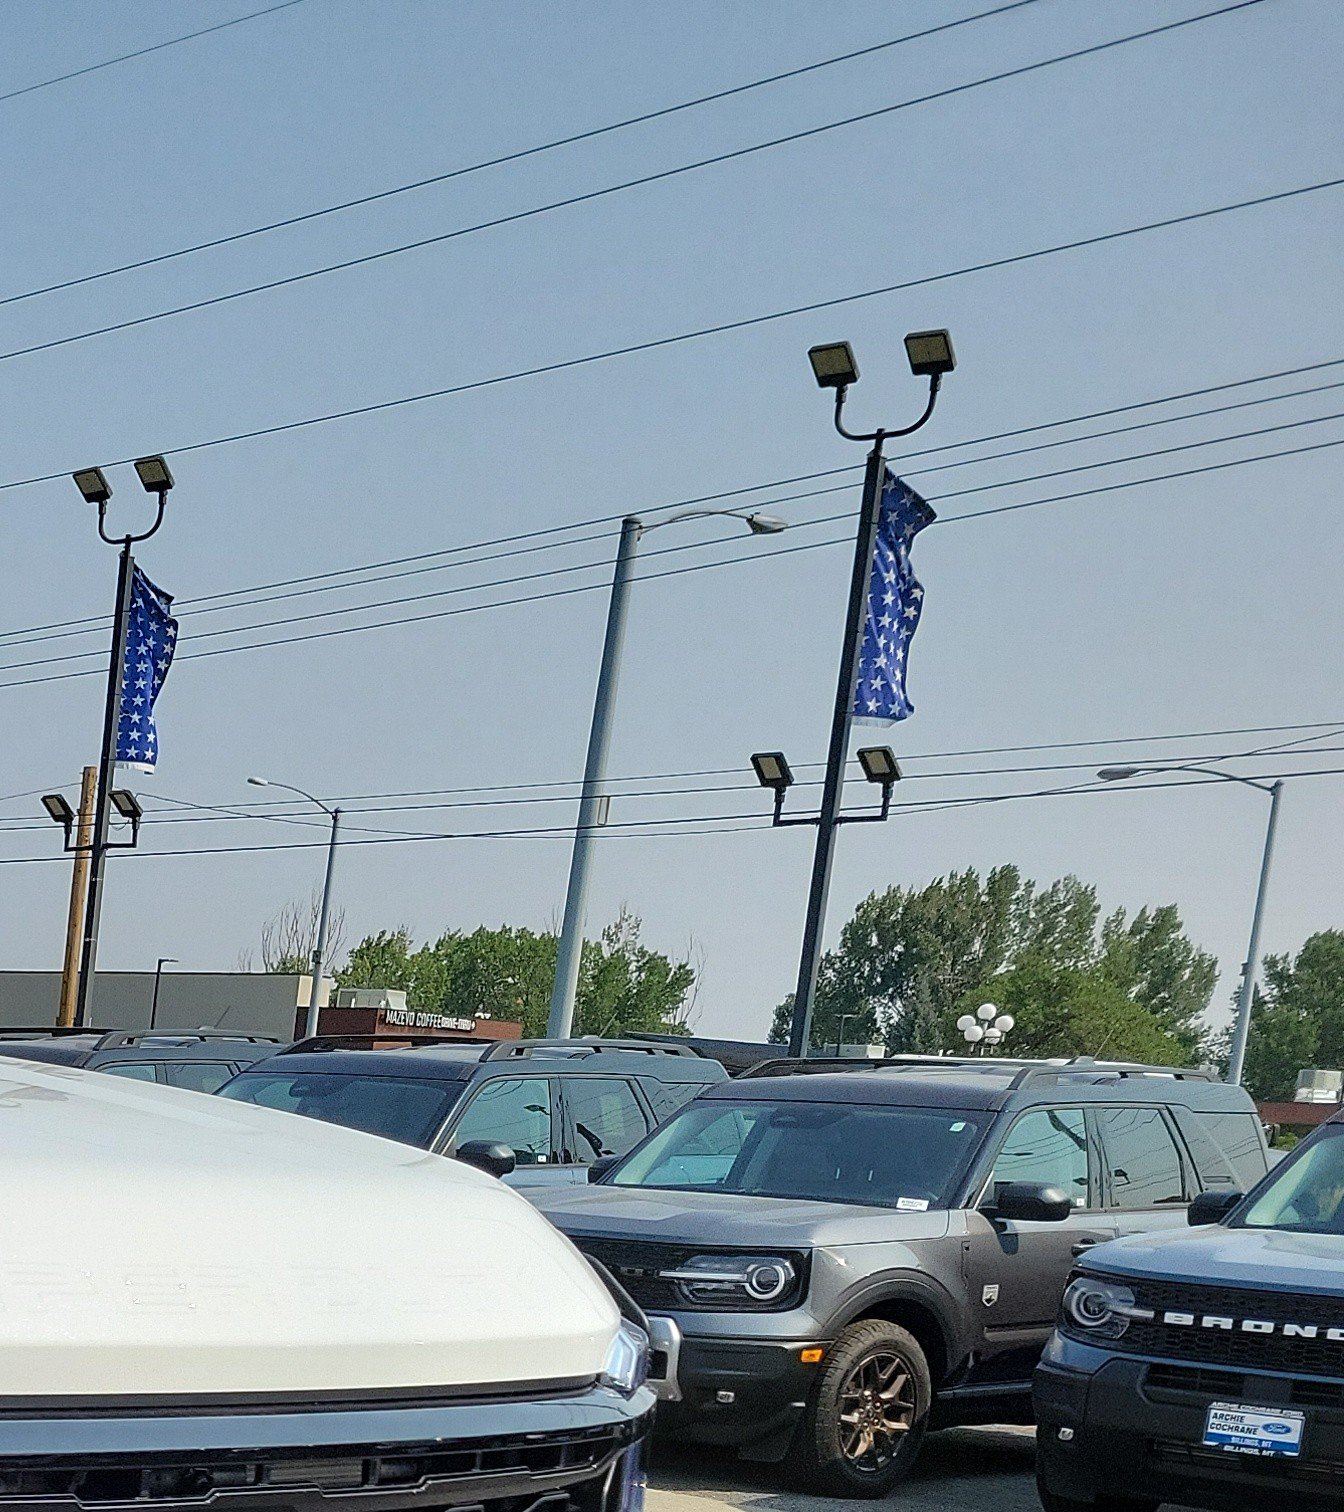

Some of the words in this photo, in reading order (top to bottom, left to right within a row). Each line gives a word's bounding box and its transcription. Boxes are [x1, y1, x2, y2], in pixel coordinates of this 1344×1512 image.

[415, 1012, 442, 1028] COFFEE
[1211, 1412, 1246, 1424] ARCHIE
[1209, 1422, 1259, 1436] COCHRANE
